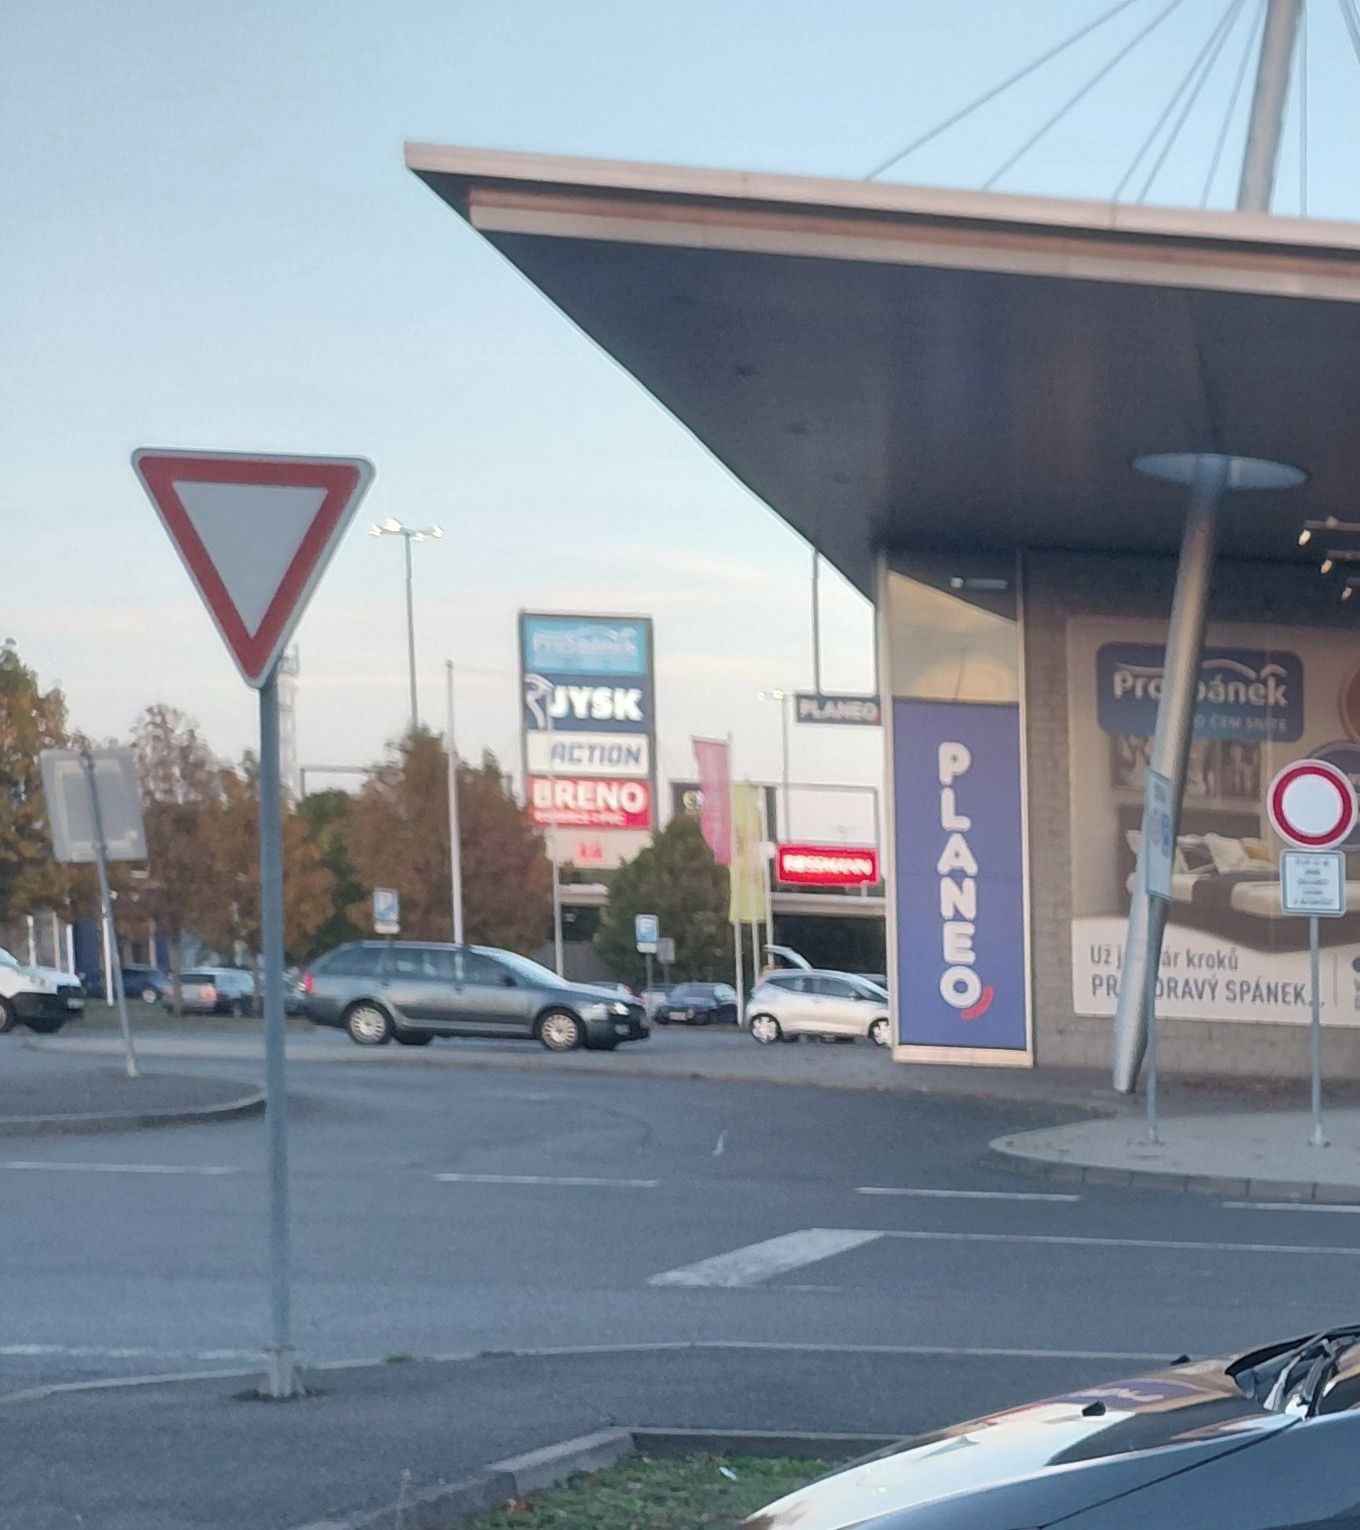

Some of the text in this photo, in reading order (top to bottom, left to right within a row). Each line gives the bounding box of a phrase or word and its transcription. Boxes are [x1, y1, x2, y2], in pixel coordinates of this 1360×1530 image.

[549, 686, 643, 721] JYSK
[1112, 669, 1289, 706] Proánek
[551, 741, 641, 766] ACTION
[533, 781, 647, 813] BRENO
[938, 742, 981, 1008] PLANEO
[1090, 944, 1111, 965] Už
[1186, 948, 1239, 971] kroků
[1092, 973, 1120, 998] PR
